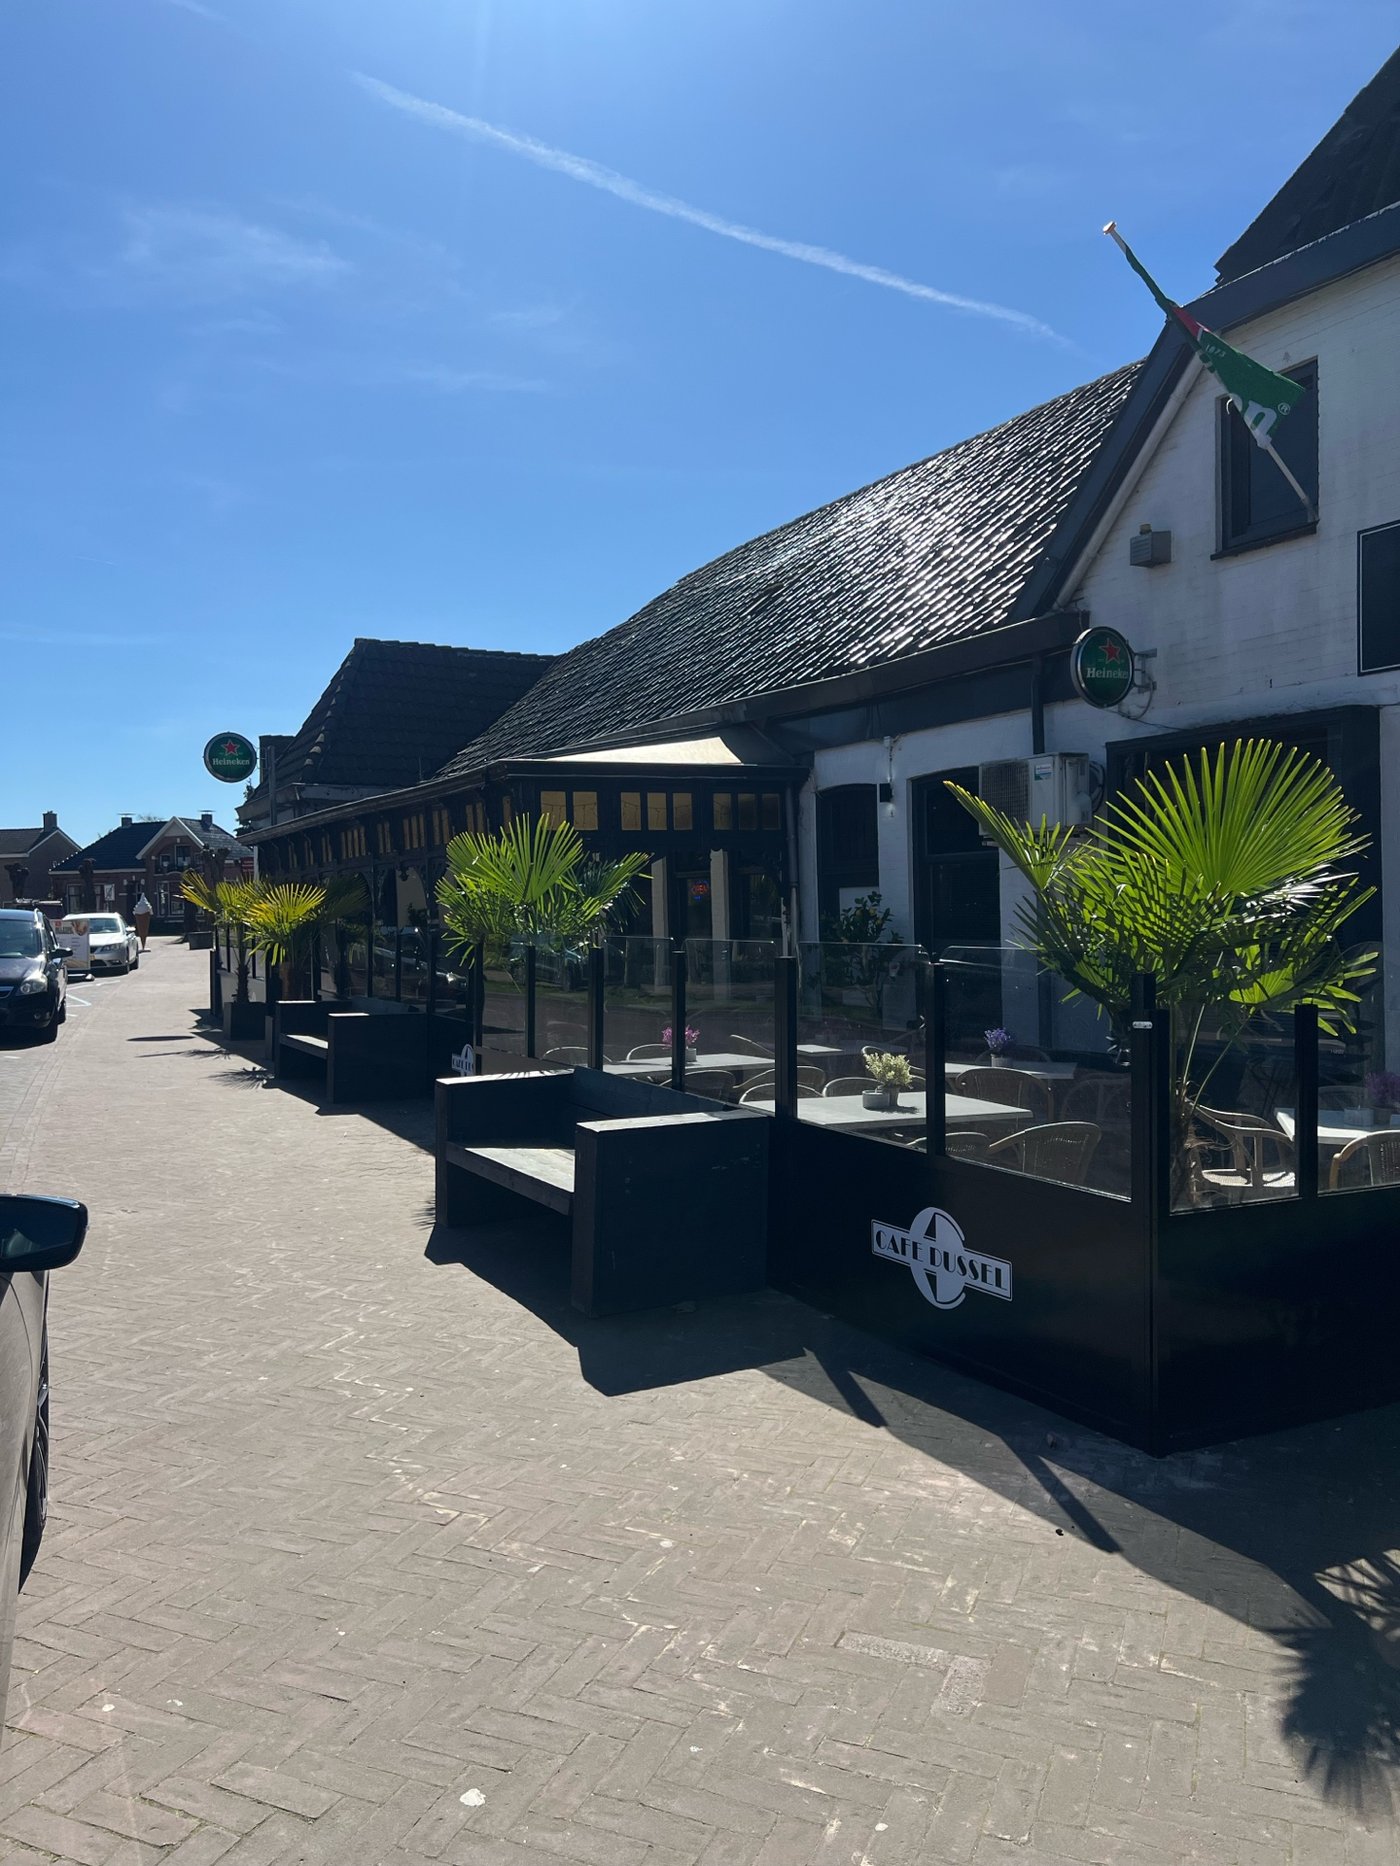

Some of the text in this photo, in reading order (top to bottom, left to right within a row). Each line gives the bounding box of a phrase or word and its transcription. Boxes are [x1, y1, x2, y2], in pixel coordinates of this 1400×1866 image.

[212, 758, 250, 766] Heineken
[875, 1230, 1007, 1291] CAFE DUSSEL
